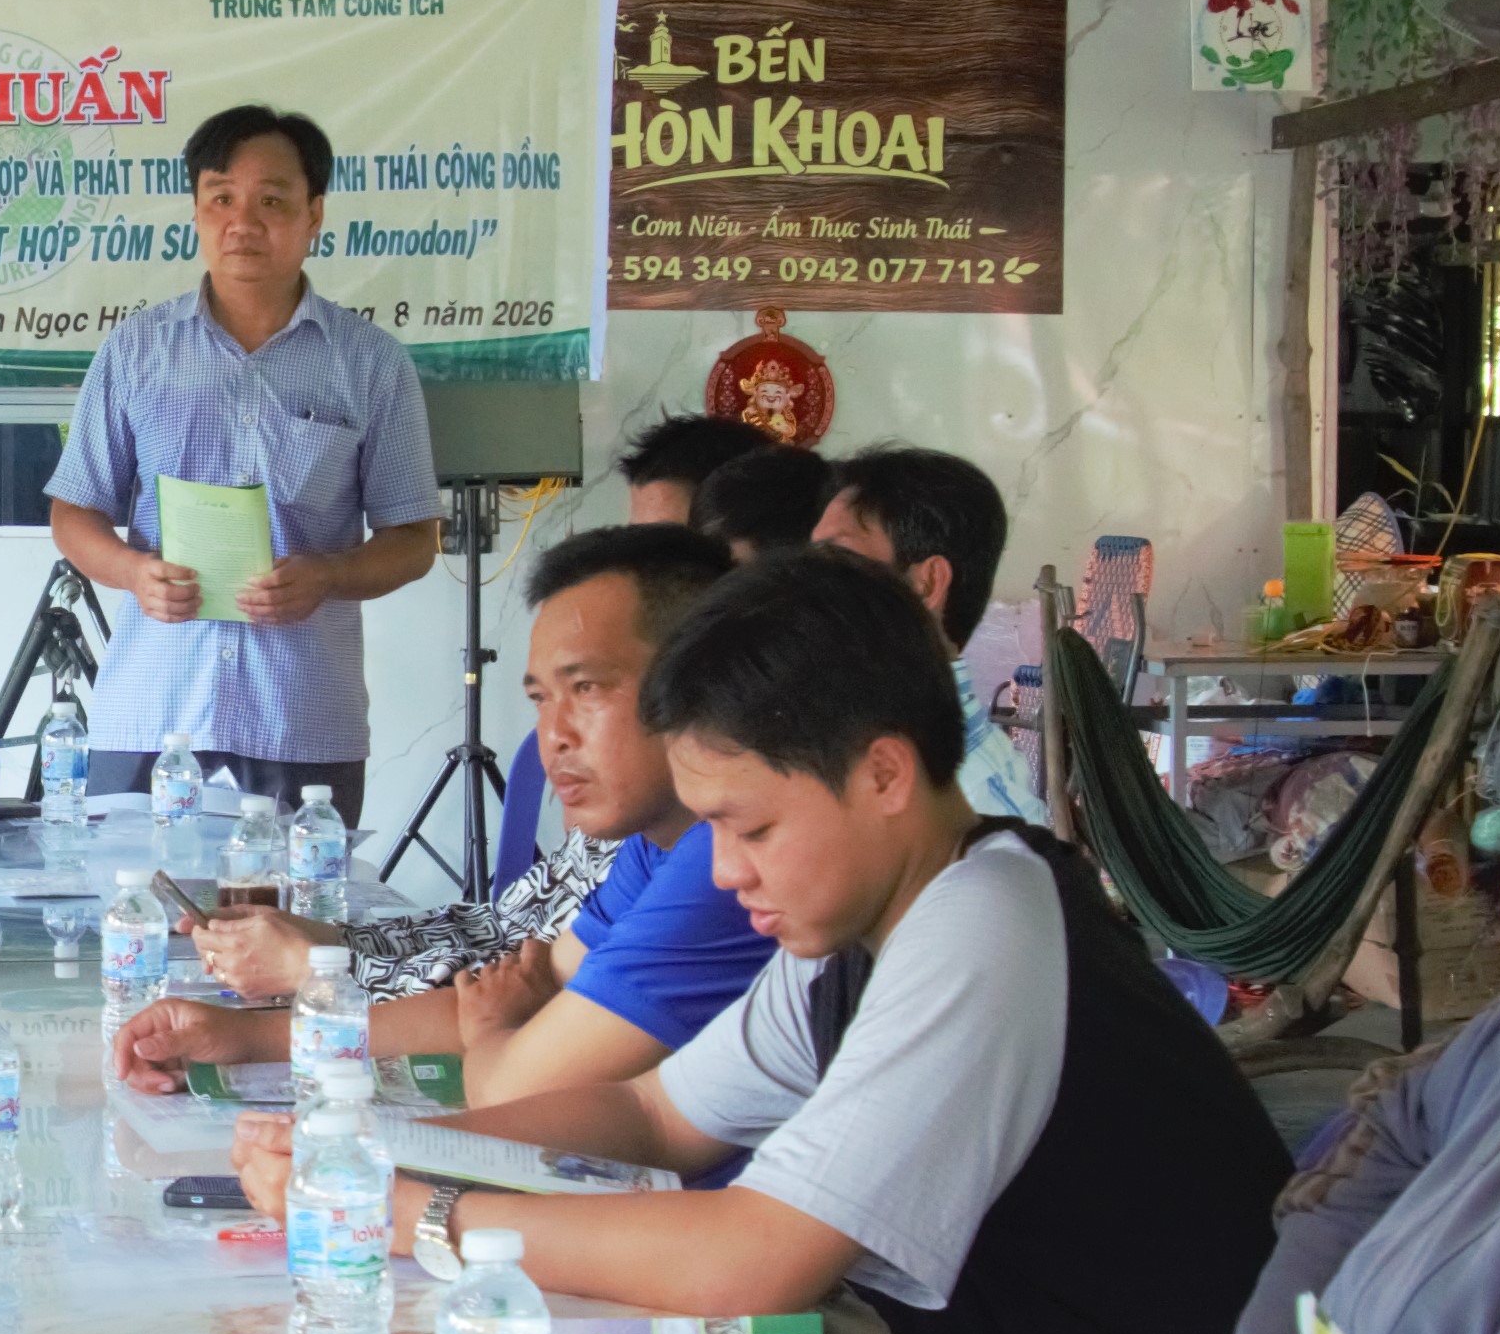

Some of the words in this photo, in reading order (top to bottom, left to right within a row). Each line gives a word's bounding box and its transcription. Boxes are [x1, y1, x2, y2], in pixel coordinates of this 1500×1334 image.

[713, 21, 826, 84] BẾN
[753, 95, 945, 176] KHOAI
[35, 150, 65, 196] VÀ
[73, 149, 133, 195] PHÁT
[141, 147, 194, 195] TRI
[374, 144, 427, 191] THÁI
[435, 142, 496, 197] CỘNG
[502, 136, 561, 190] ĐỒNG
[17, 220, 81, 270] HỢP
[90, 215, 155, 262] TÔM
[631, 214, 682, 238] Cơm
[688, 214, 742, 238] Niêu
[762, 204, 802, 239] Ẩm
[809, 215, 861, 244] Thực
[866, 215, 918, 240] Sinh
[925, 216, 973, 240] Thái
[624, 255, 683, 282] 594
[692, 256, 753, 282] 349
[779, 257, 859, 284] 0942
[867, 258, 928, 284] 077
[936, 258, 996, 285] 712
[14, 307, 89, 340] Ngọc
[97, 299, 148, 331] Hi
[394, 301, 410, 327] 8
[423, 300, 484, 327] năm
[492, 300, 555, 327] 2026
